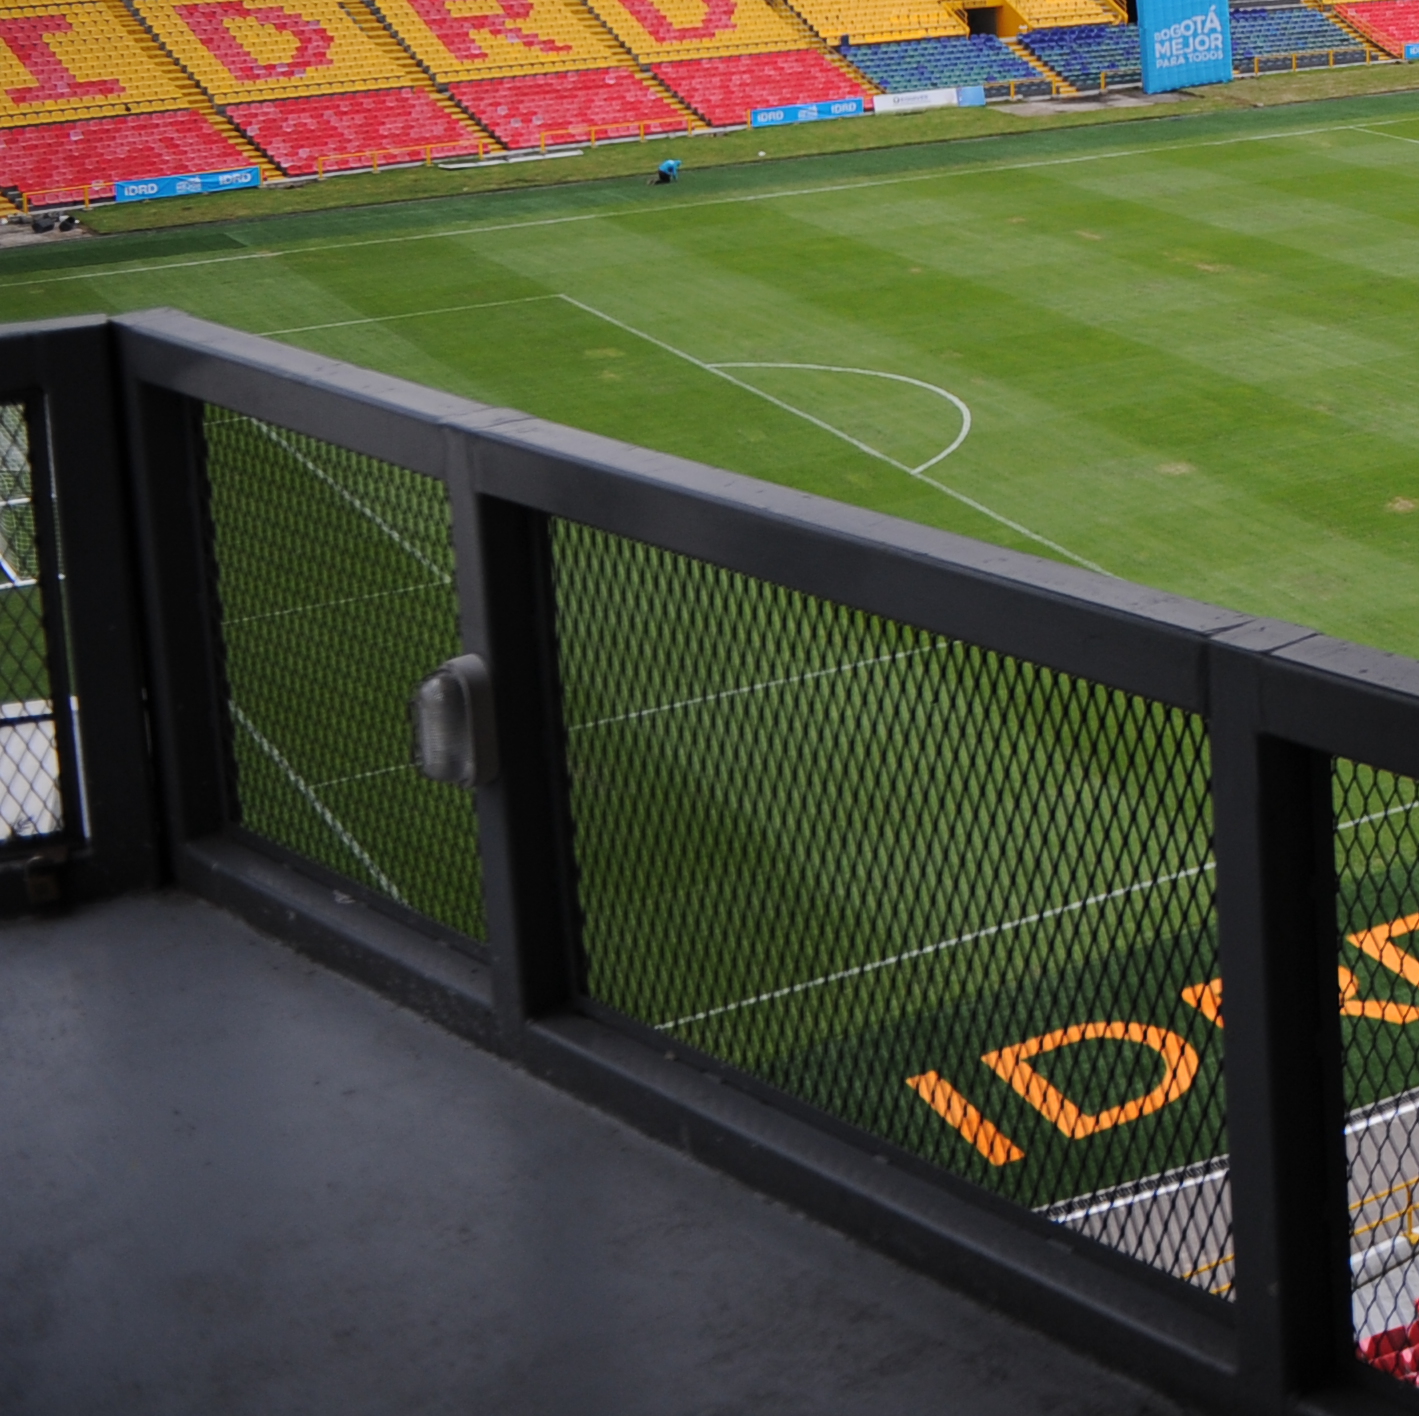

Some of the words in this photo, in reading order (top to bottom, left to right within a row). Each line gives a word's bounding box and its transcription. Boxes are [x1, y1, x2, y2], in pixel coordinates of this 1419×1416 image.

[1154, 4, 1221, 41] BOGOTÁ
[1155, 33, 1223, 58] MEJOR
[1156, 55, 1185, 69] PARA
[1187, 51, 1224, 63] TODOS
[831, 102, 857, 114] IDRD
[757, 110, 784, 123] IDRD
[219, 172, 252, 185] IDRD
[124, 183, 158, 196] IDRD
